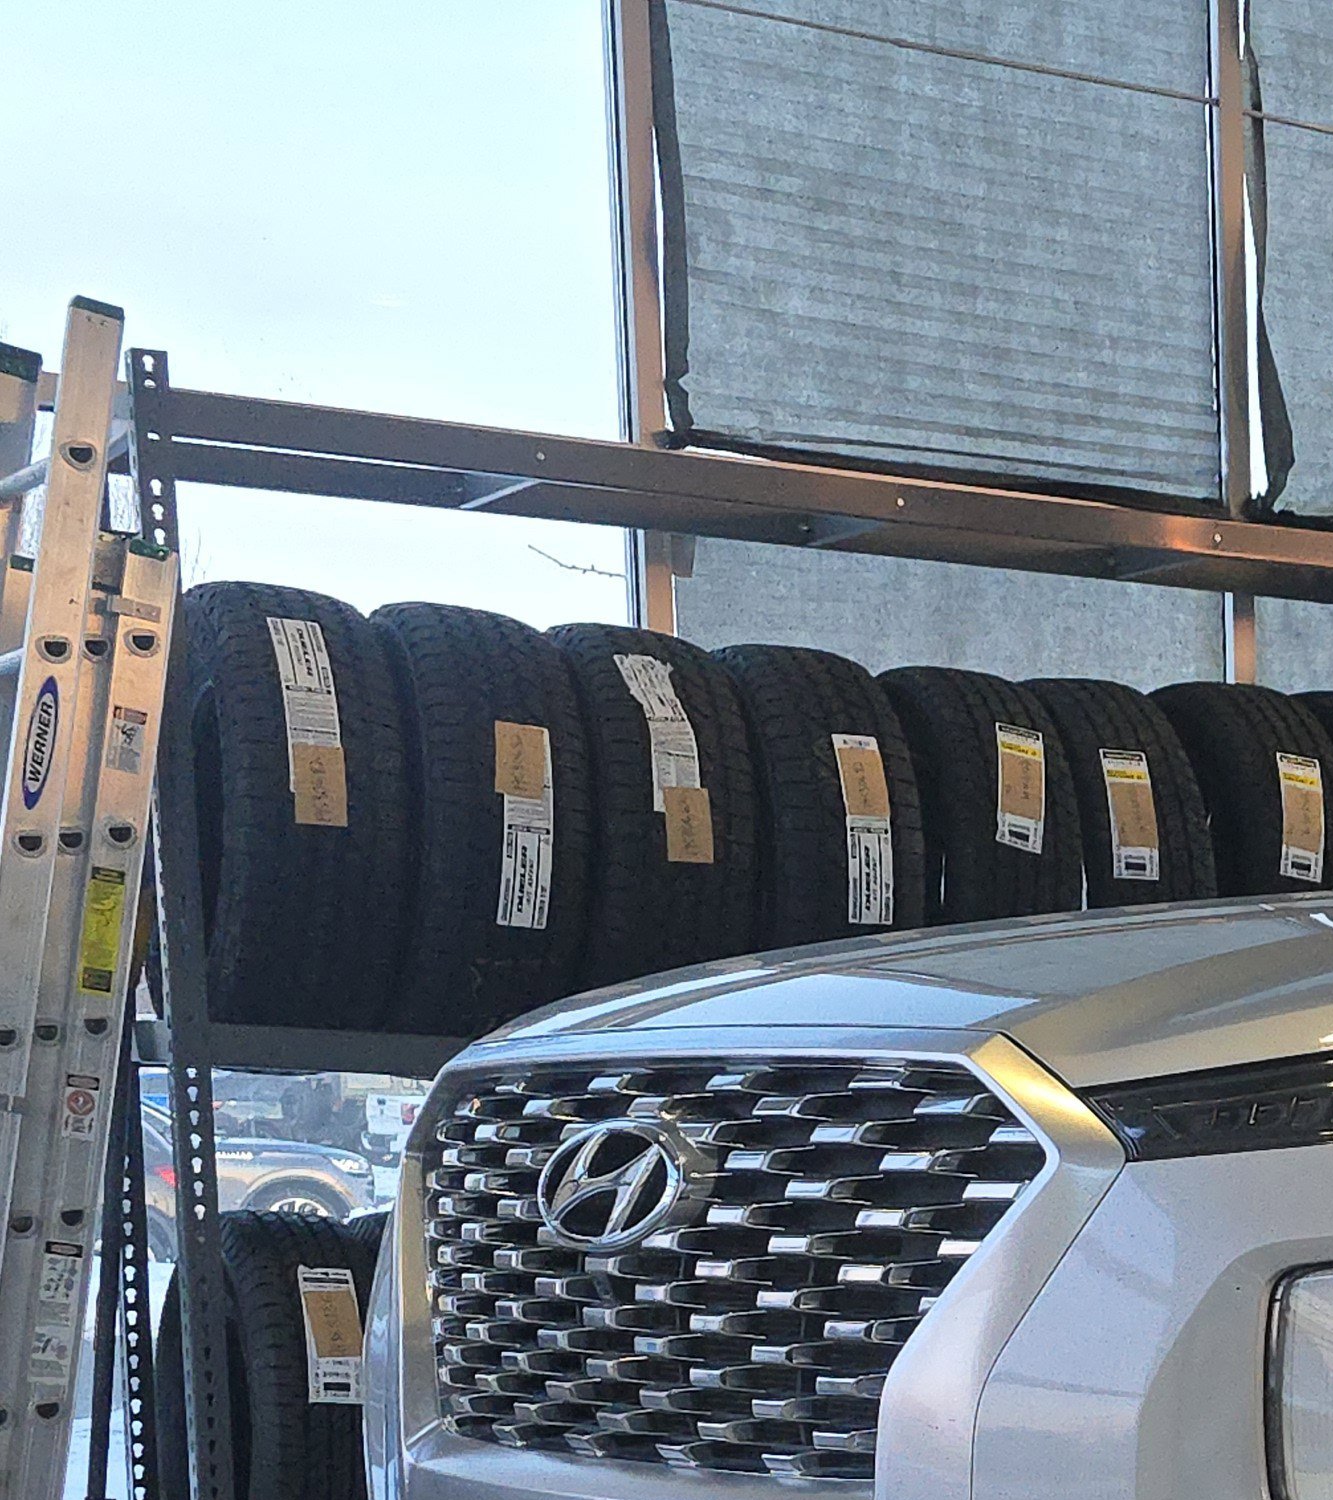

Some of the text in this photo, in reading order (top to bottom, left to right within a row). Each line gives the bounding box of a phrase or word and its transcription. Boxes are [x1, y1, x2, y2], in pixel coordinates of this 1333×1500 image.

[27, 700, 54, 783] WERNER
[517, 845, 528, 914] DUELER
[864, 845, 872, 912] DUELER
